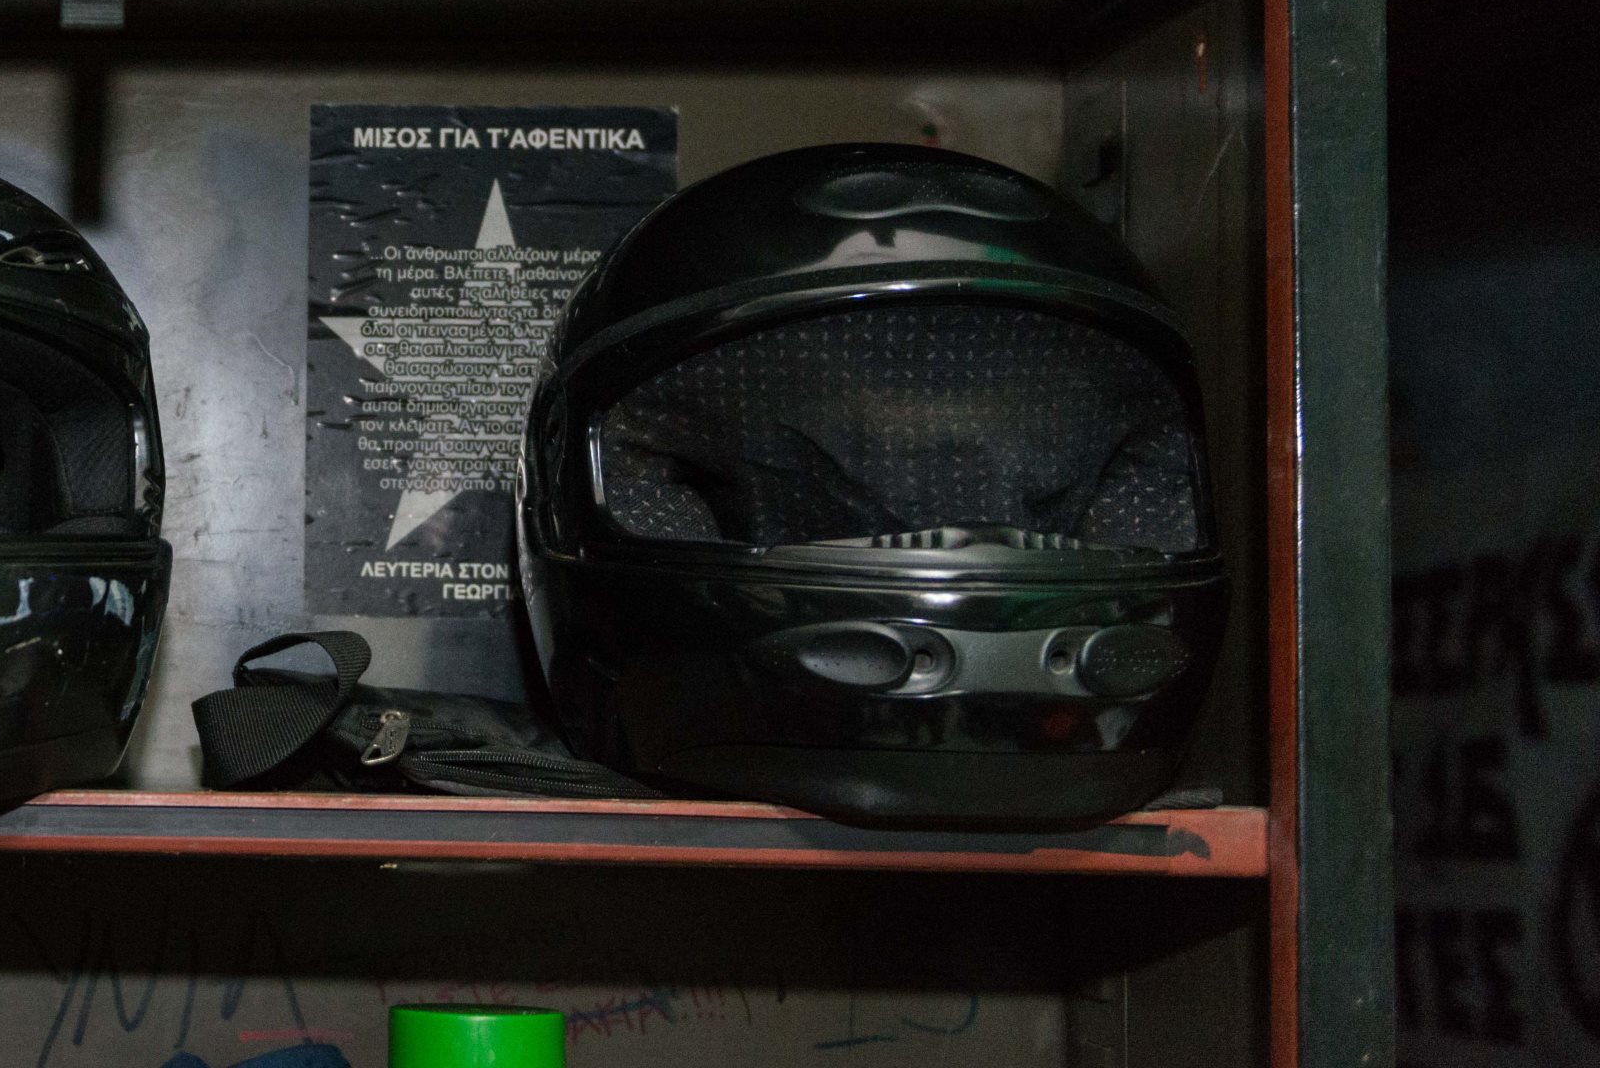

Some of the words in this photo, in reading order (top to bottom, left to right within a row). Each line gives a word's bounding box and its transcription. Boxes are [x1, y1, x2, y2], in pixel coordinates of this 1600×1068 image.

[352, 127, 431, 149] ΜΙΣΟΣ
[439, 127, 480, 149] ΓΙΑ
[406, 245, 483, 264] άνθρωποι
[487, 245, 558, 265] αλλάζουν
[563, 246, 602, 266] μέρα
[376, 268, 392, 282] τη
[515, 266, 588, 285] μαθαίνον
[410, 285, 454, 303] αυτές
[459, 288, 478, 302] τις
[482, 285, 547, 303] αλήθειες
[553, 289, 571, 300] κα
[367, 303, 517, 322] συνειδητοποιώντας
[522, 307, 538, 319] τα
[362, 322, 393, 336] όλοι
[399, 325, 412, 336] οι
[400, 340, 420, 355] θα
[424, 341, 503, 357] οπλιστούν
[508, 345, 526, 361] με
[385, 360, 406, 376] θα
[410, 361, 493, 379] σαρώσουν
[364, 380, 451, 399] παίρνοντας
[457, 379, 496, 395] πίσω
[406, 398, 517, 418] δημιούργησαν
[360, 419, 385, 431] τον
[485, 421, 502, 432] το
[383, 435, 484, 455] προτιμήσουν
[488, 440, 507, 451] να
[363, 457, 402, 473] εσείς
[407, 460, 426, 470] να
[380, 475, 460, 494] στενάζουν
[463, 476, 495, 491] από
[360, 561, 454, 578] ΛΕΥΤΕΡΙΑ
[459, 563, 509, 579] ΣΤΟΝ
[443, 583, 510, 600] ΓΕΩΡΓΙ
